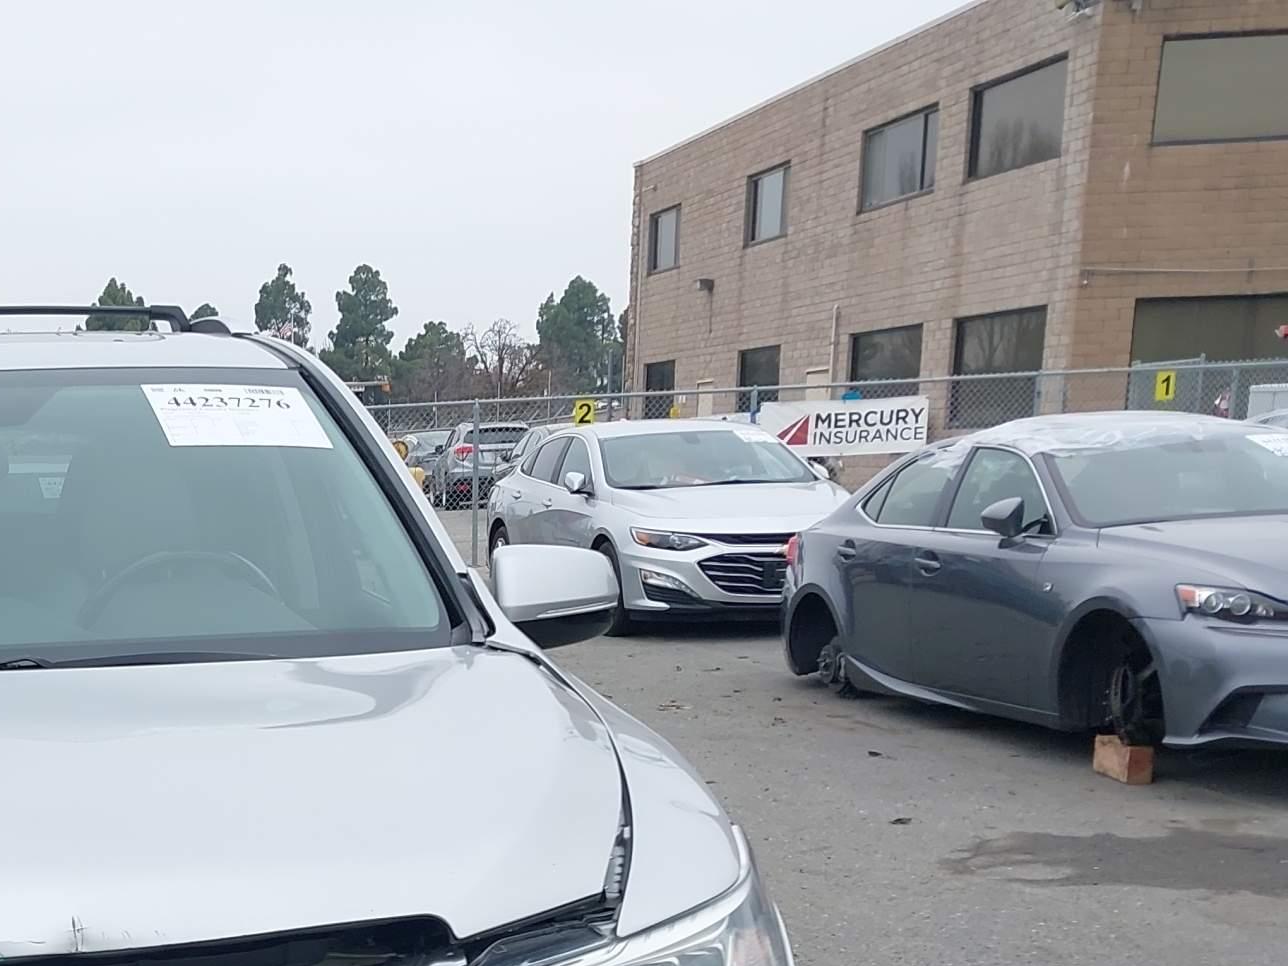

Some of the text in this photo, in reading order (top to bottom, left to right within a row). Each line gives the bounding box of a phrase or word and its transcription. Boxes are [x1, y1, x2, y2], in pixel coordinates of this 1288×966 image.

[1161, 375, 1171, 396] 1
[167, 396, 291, 409] 44237276
[578, 403, 592, 424] 2
[814, 407, 925, 429] MERCURY
[812, 426, 925, 446] INSURANCE
